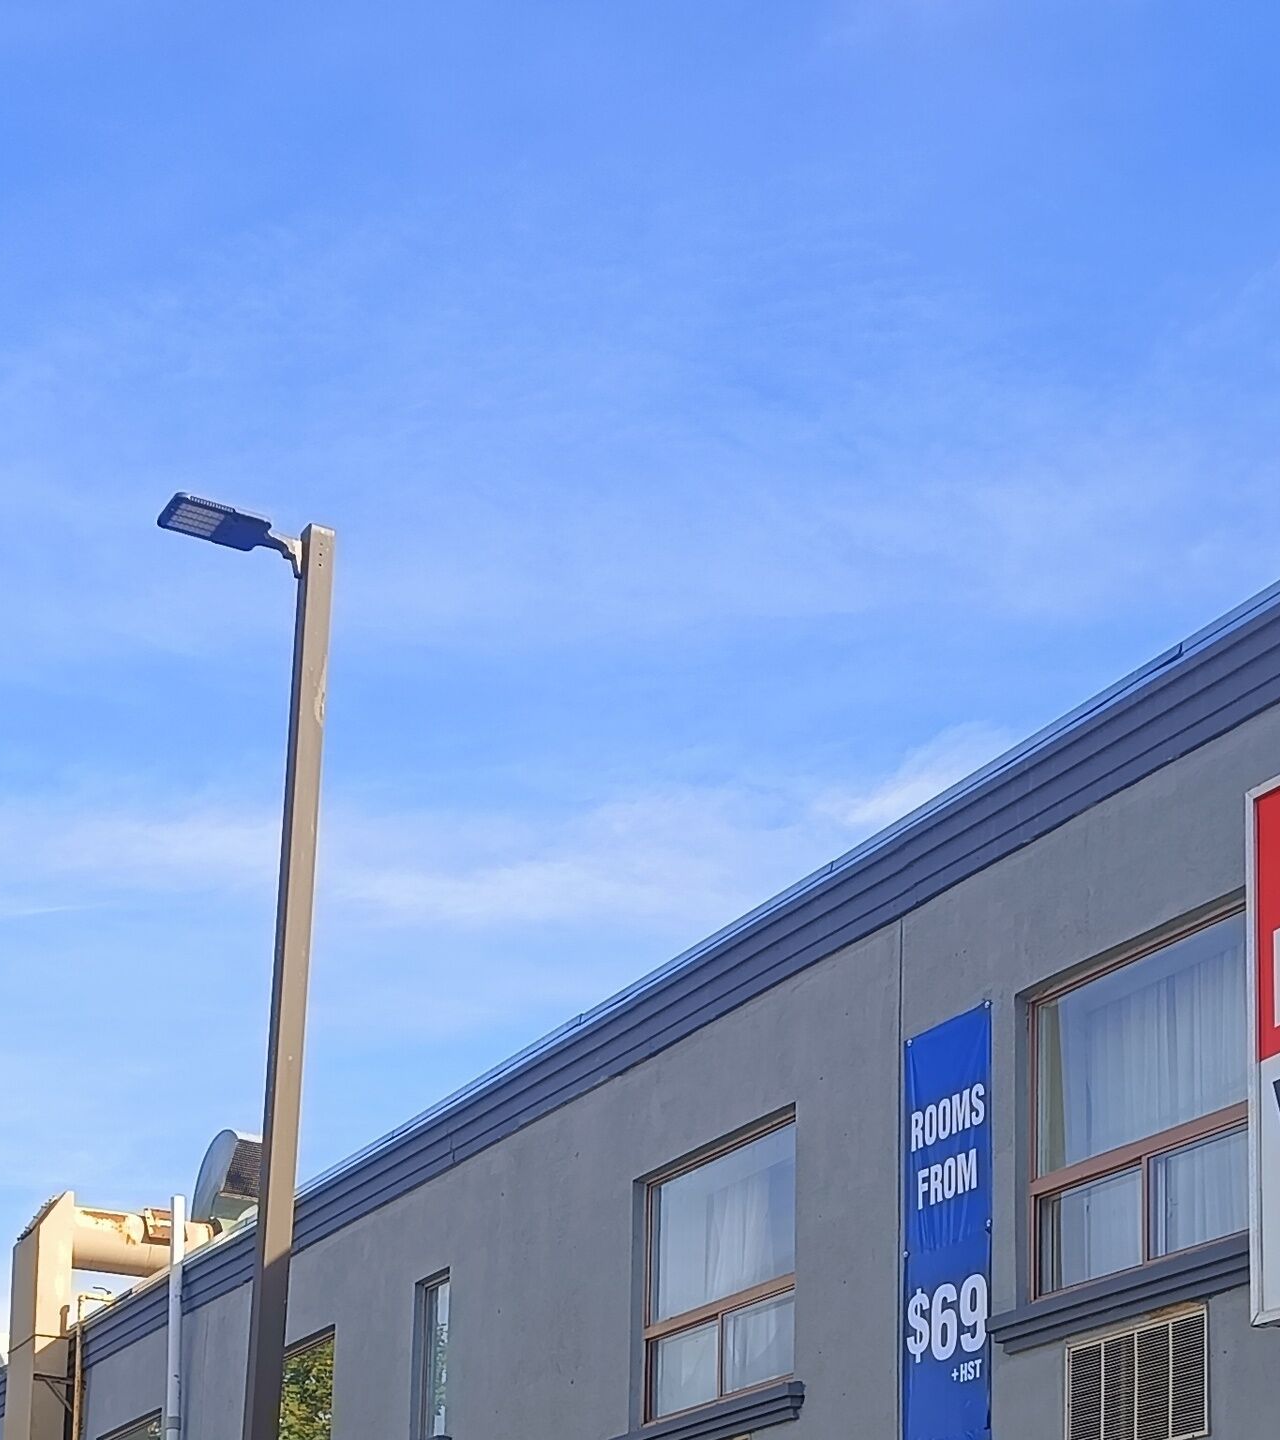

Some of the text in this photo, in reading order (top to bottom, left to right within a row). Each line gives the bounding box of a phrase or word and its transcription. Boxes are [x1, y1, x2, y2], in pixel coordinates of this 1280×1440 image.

[911, 1083, 985, 1152] ROOMS
[918, 1149, 977, 1210] FROM
[907, 1273, 988, 1363] $69
[952, 1359, 982, 1383] +HST
